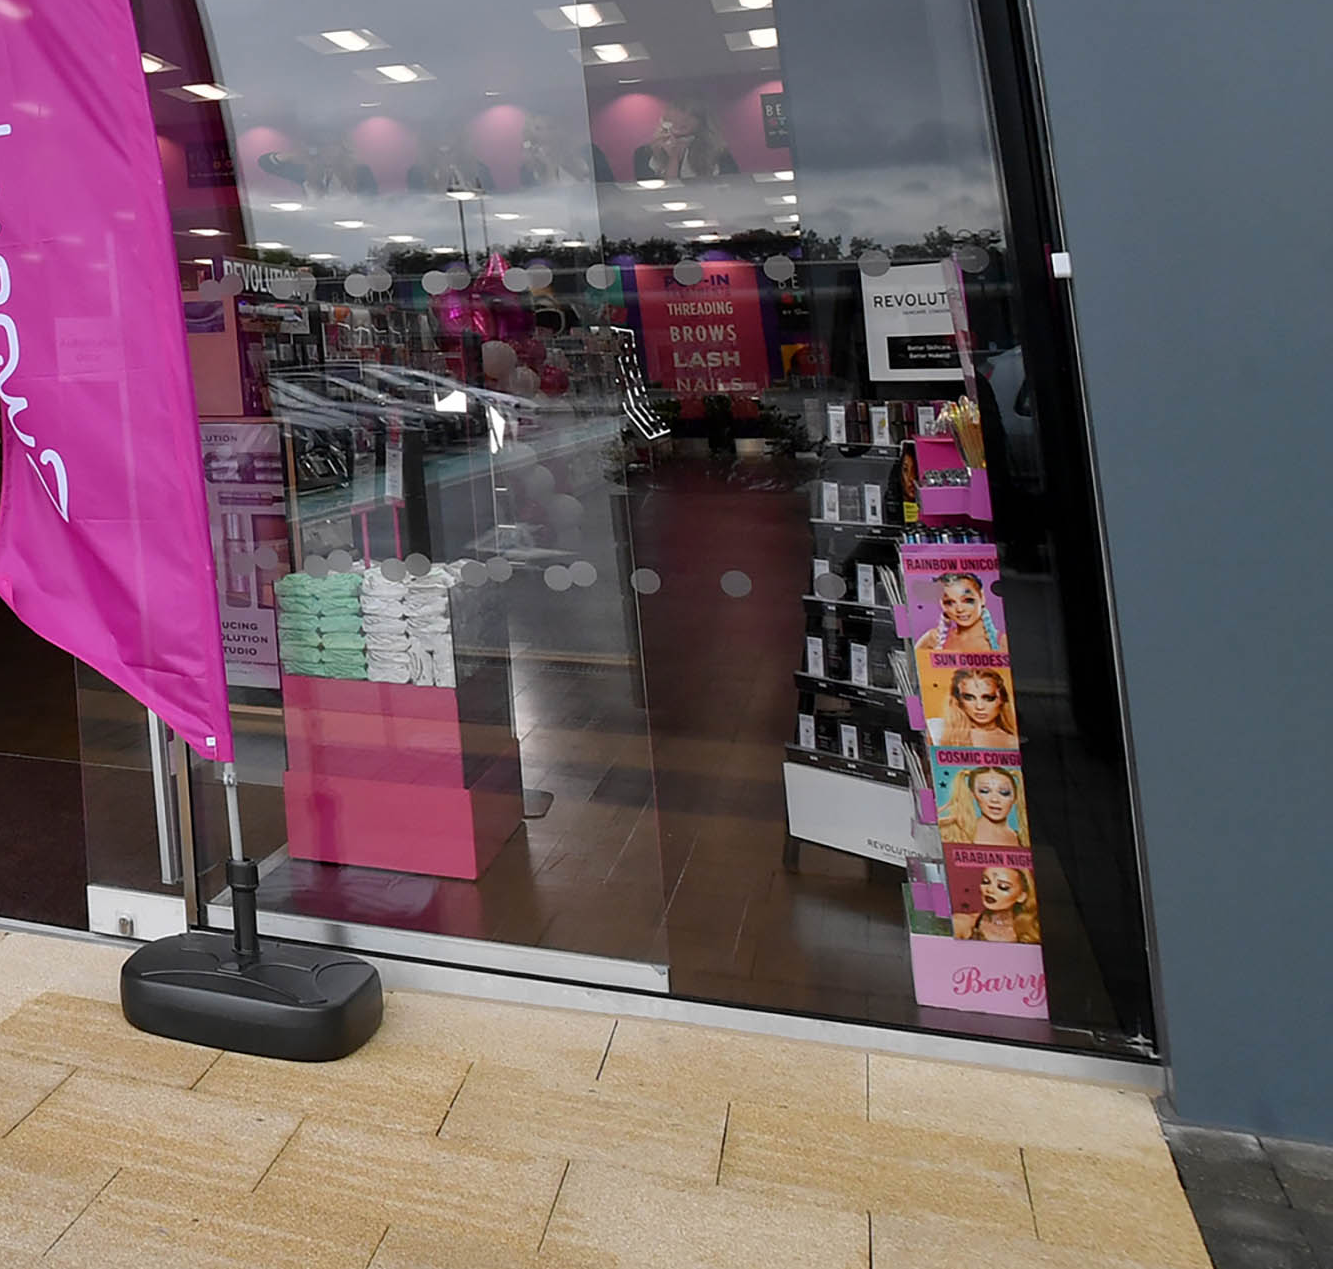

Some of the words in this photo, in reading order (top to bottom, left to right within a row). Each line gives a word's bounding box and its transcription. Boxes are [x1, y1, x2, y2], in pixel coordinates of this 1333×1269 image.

[664, 273, 730, 288] P-IN
[667, 301, 733, 316] THREADING
[669, 325, 737, 343] BROWS
[673, 351, 741, 368] LASH
[676, 376, 744, 392] NAILS
[906, 558, 957, 571] RAINBOW
[934, 653, 957, 666] SUN
[958, 654, 1012, 666] GODDESS
[939, 751, 982, 765] COSMIC
[953, 850, 1004, 865] ARABIAN
[951, 966, 1049, 1008] Barry
